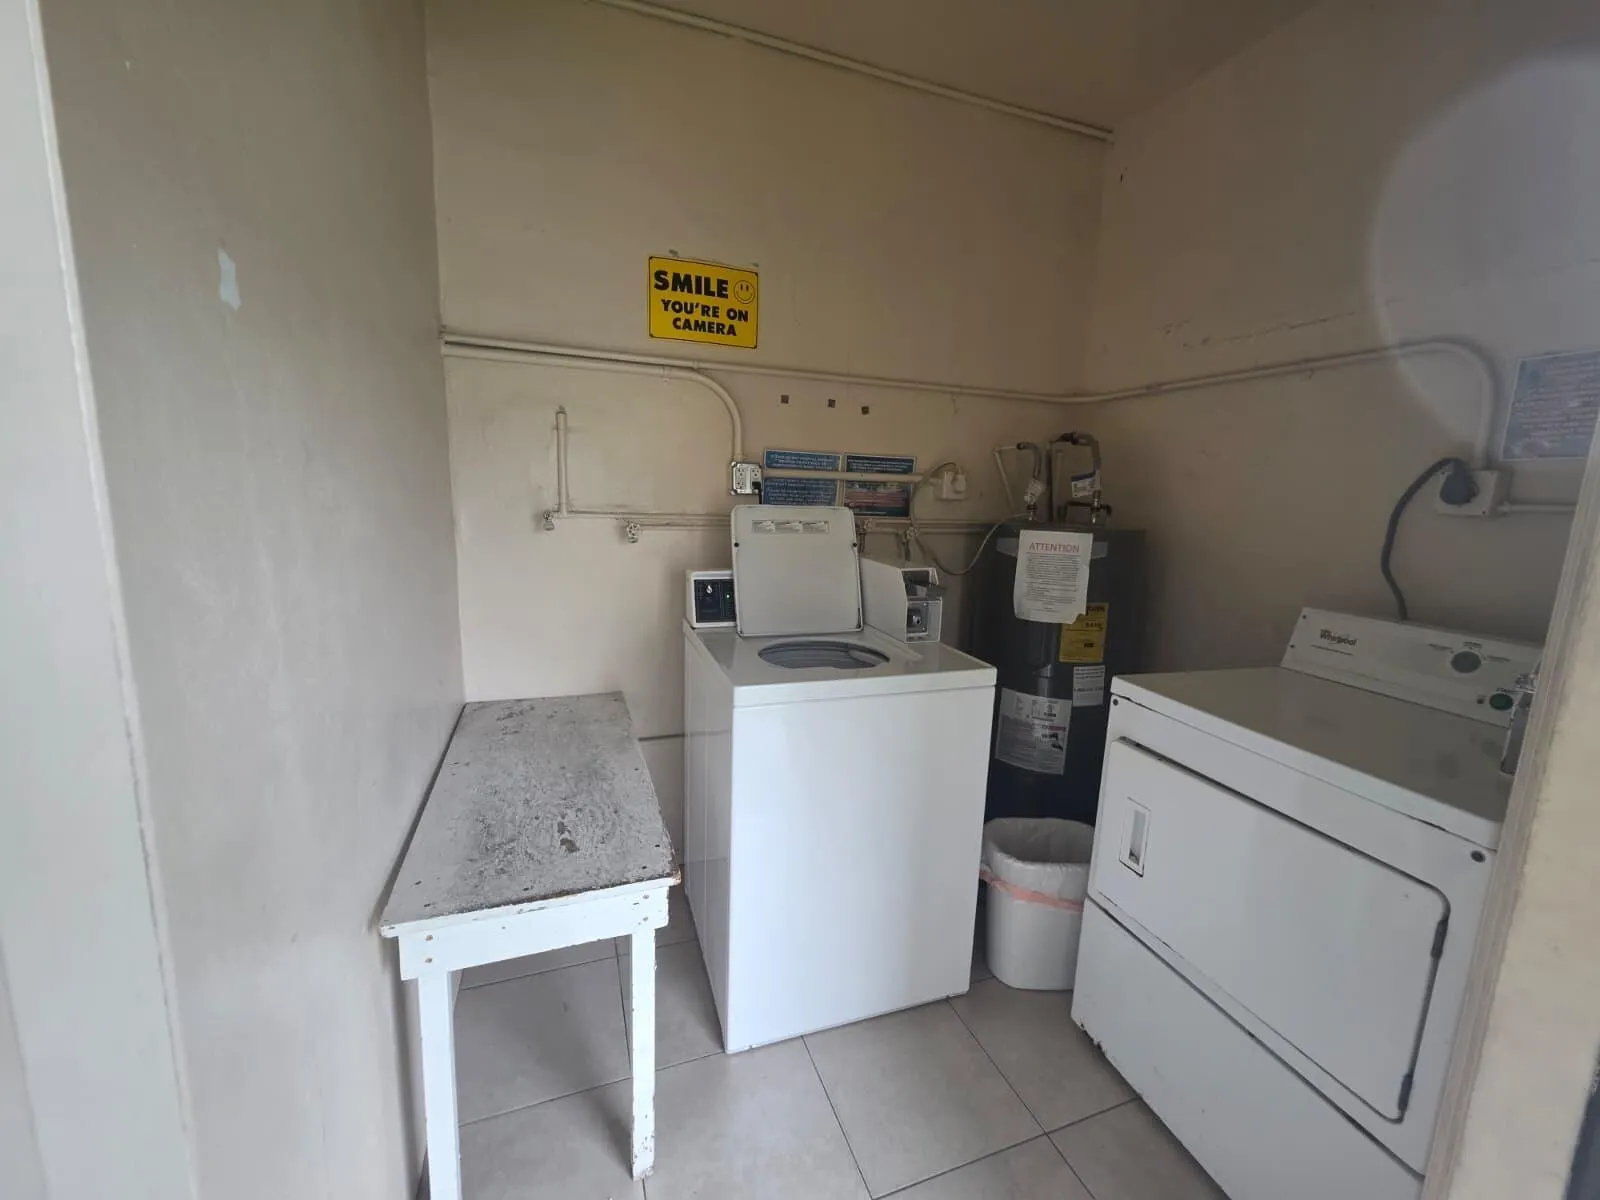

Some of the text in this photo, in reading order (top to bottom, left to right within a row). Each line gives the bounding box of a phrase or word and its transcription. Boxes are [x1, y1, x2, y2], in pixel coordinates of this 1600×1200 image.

[654, 270, 728, 299] SMILE
[661, 299, 748, 322] YOU'RE ON
[672, 317, 736, 336] CAMERA
[1029, 542, 1080, 553] ATTENTION
[1320, 631, 1358, 647] Whirlpool
